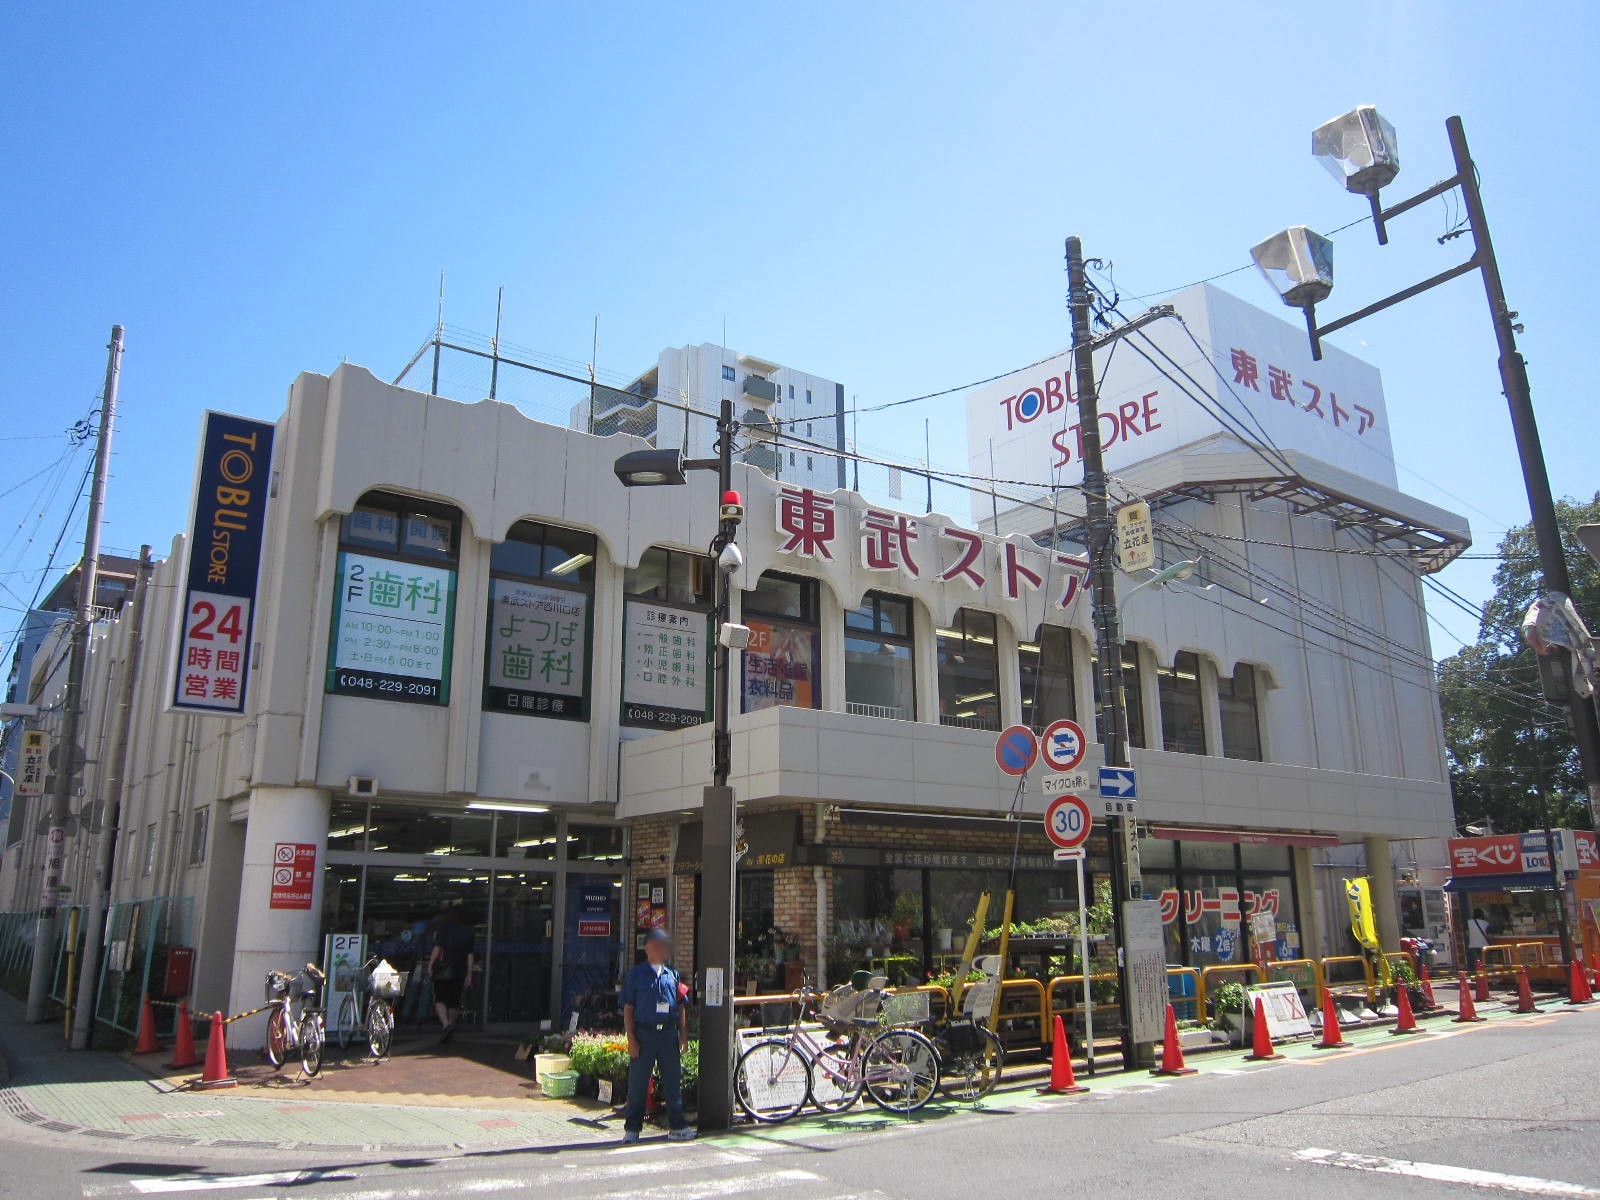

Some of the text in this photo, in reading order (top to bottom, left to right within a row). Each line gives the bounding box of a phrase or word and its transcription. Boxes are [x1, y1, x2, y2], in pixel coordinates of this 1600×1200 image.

[1230, 347, 1375, 436] 東武ストア
[214, 432, 257, 531] TOBU
[777, 488, 1095, 608] 東武ストア
[1123, 533, 1150, 549] 立花屋
[207, 529, 231, 585] STORE
[369, 571, 442, 615] 歯科
[188, 601, 243, 644] 24
[499, 613, 579, 647] よつば
[646, 610, 690, 626] 診療案内
[748, 629, 767, 648] 2F
[187, 647, 240, 673] 時間
[502, 643, 573, 686] 歯科
[185, 674, 238, 700] 営業
[348, 676, 437, 696] 048-229-2091
[507, 693, 564, 713] 日曜診療
[634, 709, 703, 725] 048-229-2091
[1045, 775, 1088, 791] マイクロを除く
[1055, 808, 1081, 833] 30
[1454, 845, 1516, 868] 宝くじ
[1161, 889, 1279, 924] クリーニング
[335, 936, 359, 950] 2F
